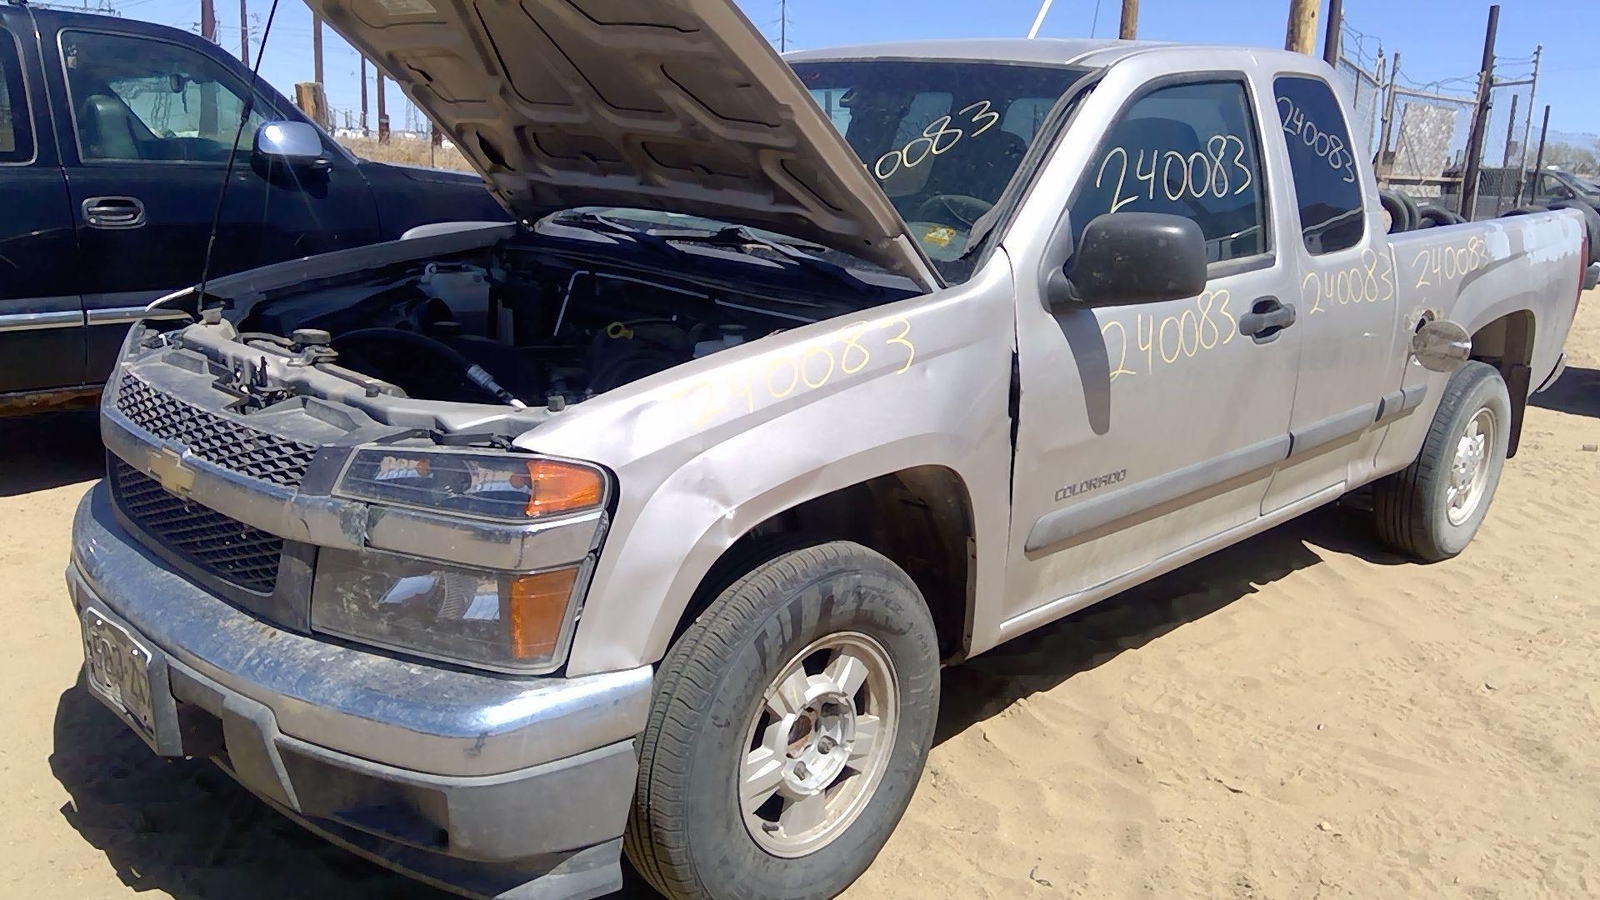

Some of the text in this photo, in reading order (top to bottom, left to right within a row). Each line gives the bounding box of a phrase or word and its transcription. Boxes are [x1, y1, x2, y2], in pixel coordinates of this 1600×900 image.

[1096, 134, 1252, 214] 240083
[1277, 96, 1355, 183] 240083
[1302, 248, 1394, 315] 240083
[1411, 235, 1489, 289] 240083
[671, 317, 915, 430] 240083
[1101, 289, 1237, 382] 240083
[1054, 468, 1127, 502] COLORADO
